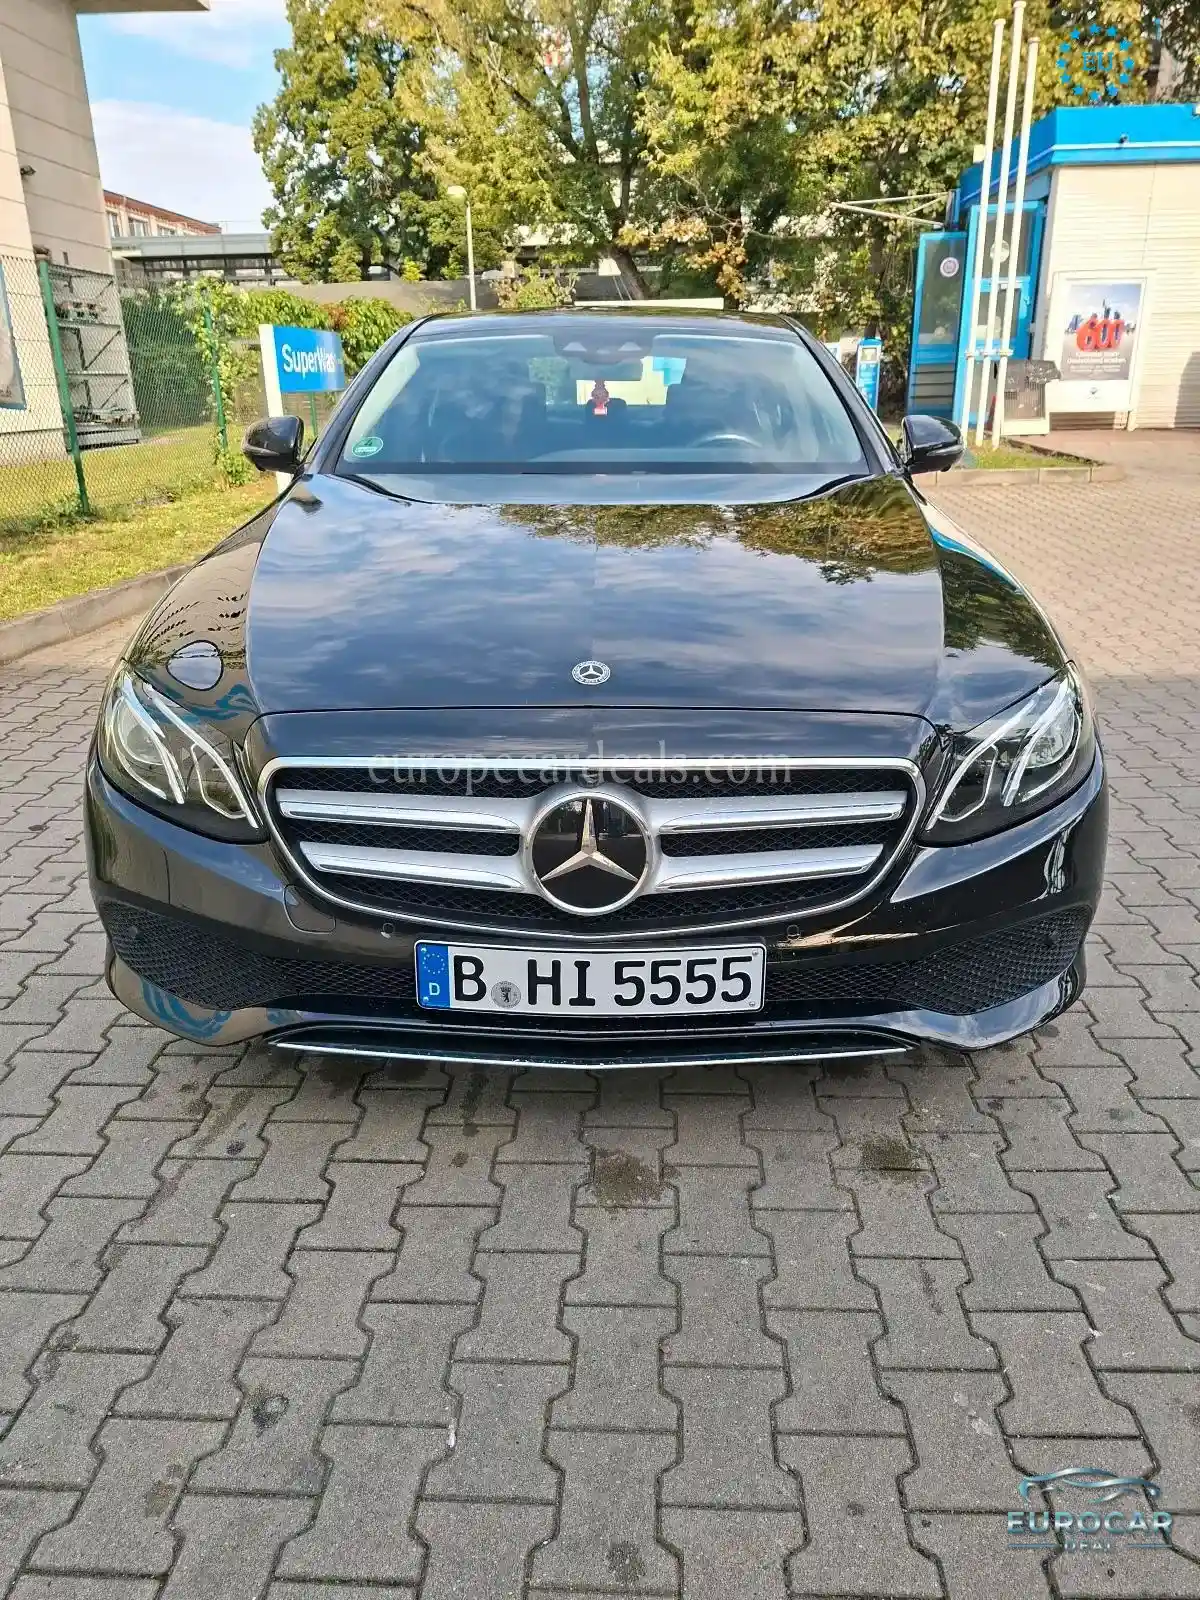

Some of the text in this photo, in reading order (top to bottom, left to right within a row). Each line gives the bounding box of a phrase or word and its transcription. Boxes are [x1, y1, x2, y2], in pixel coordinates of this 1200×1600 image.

[281, 343, 337, 380] SuperWas
[428, 982, 440, 996] D
[453, 954, 487, 1002] B
[527, 959, 596, 1006] HI
[614, 955, 753, 1007] 5555
